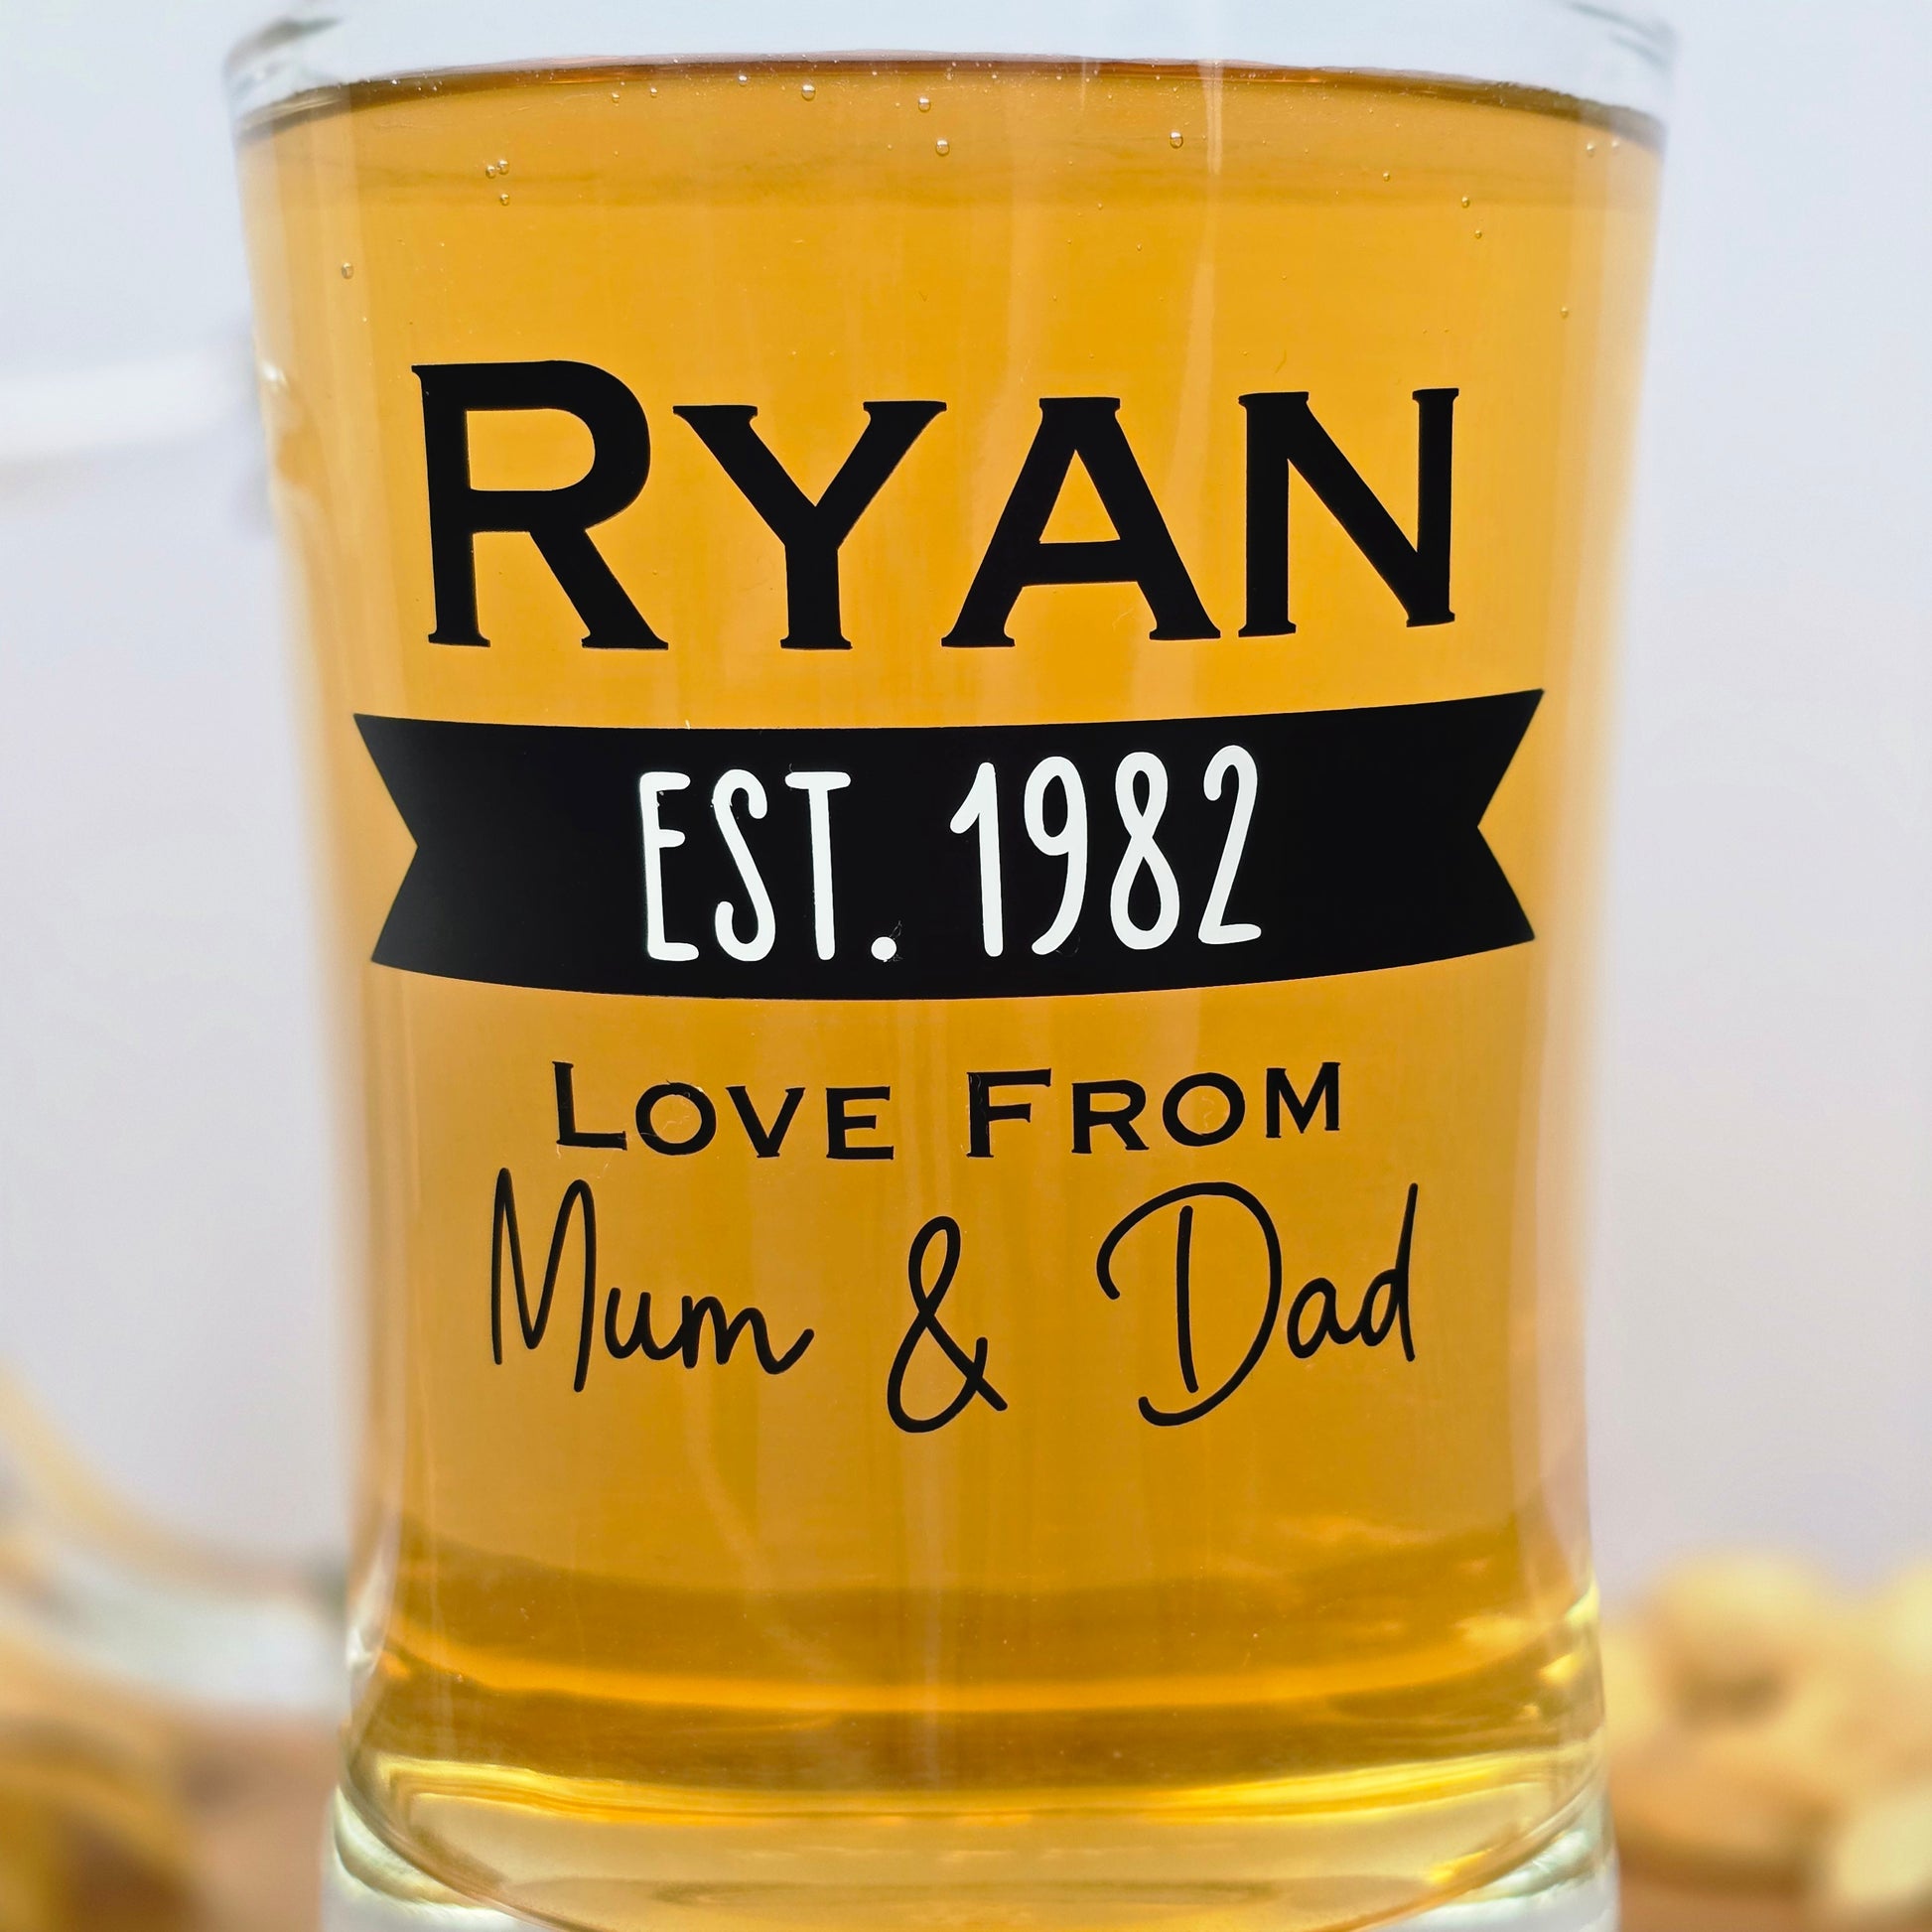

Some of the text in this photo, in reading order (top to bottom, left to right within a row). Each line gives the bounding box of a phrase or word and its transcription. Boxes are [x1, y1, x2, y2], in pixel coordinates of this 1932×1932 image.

[411, 359, 1459, 650] RYAN
[638, 745, 1262, 963] EST. 1982
[552, 1060, 1341, 1161] LOVE FROM
[490, 1168, 1419, 1434] Mum & Dad
